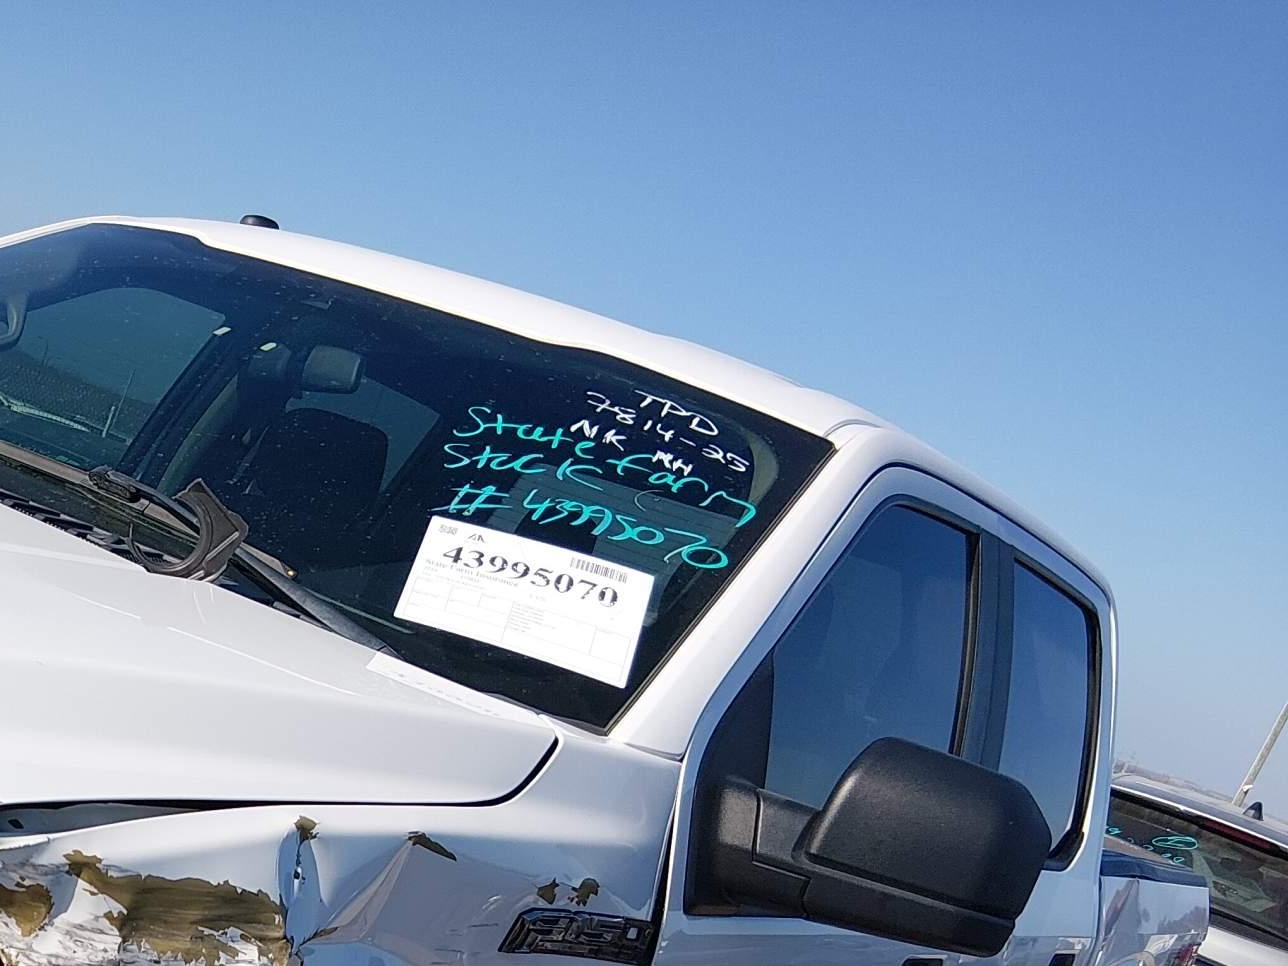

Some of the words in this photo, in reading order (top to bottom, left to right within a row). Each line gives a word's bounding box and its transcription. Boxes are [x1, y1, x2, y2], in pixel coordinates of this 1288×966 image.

[634, 389, 719, 436] TPD
[523, 488, 729, 569] 43995070
[443, 546, 619, 608] 43995070
